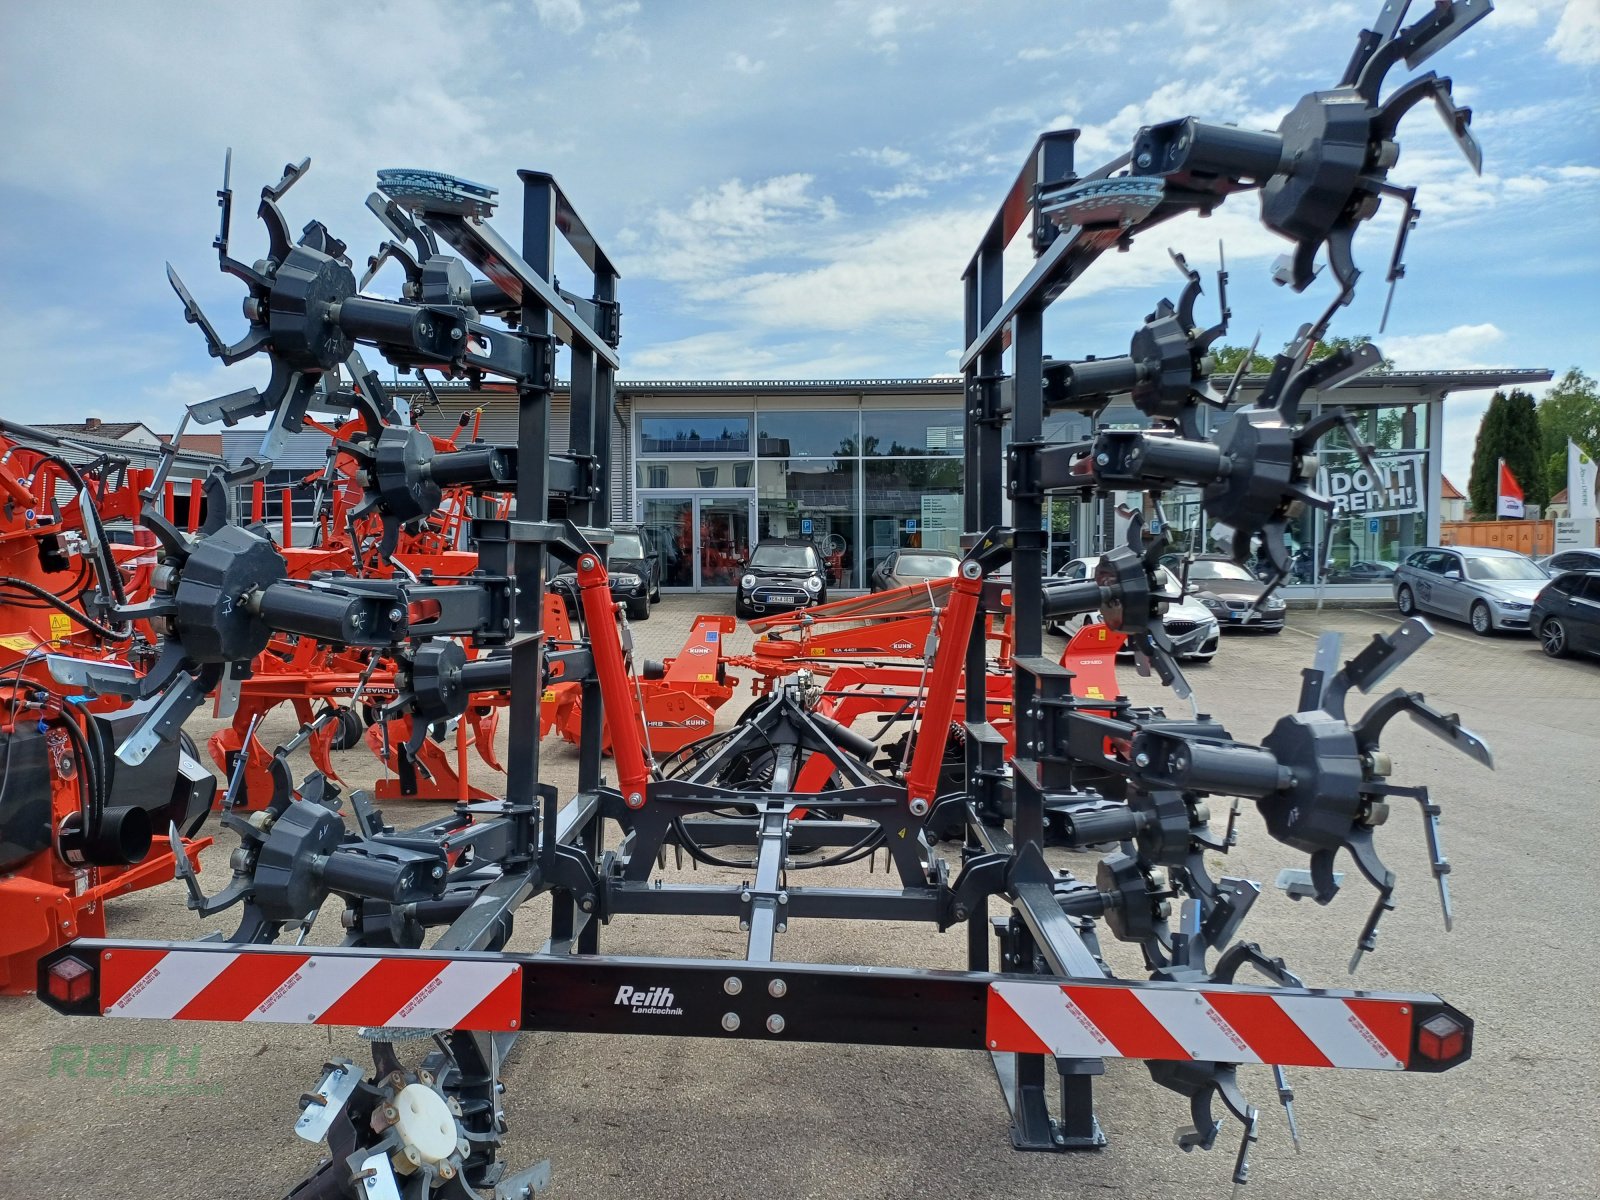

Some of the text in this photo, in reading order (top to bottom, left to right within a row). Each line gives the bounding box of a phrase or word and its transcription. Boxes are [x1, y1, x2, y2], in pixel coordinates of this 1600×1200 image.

[1331, 465, 1410, 494] DO IT
[614, 985, 674, 1007] Reith
[632, 1006, 683, 1016] Landtechnik
